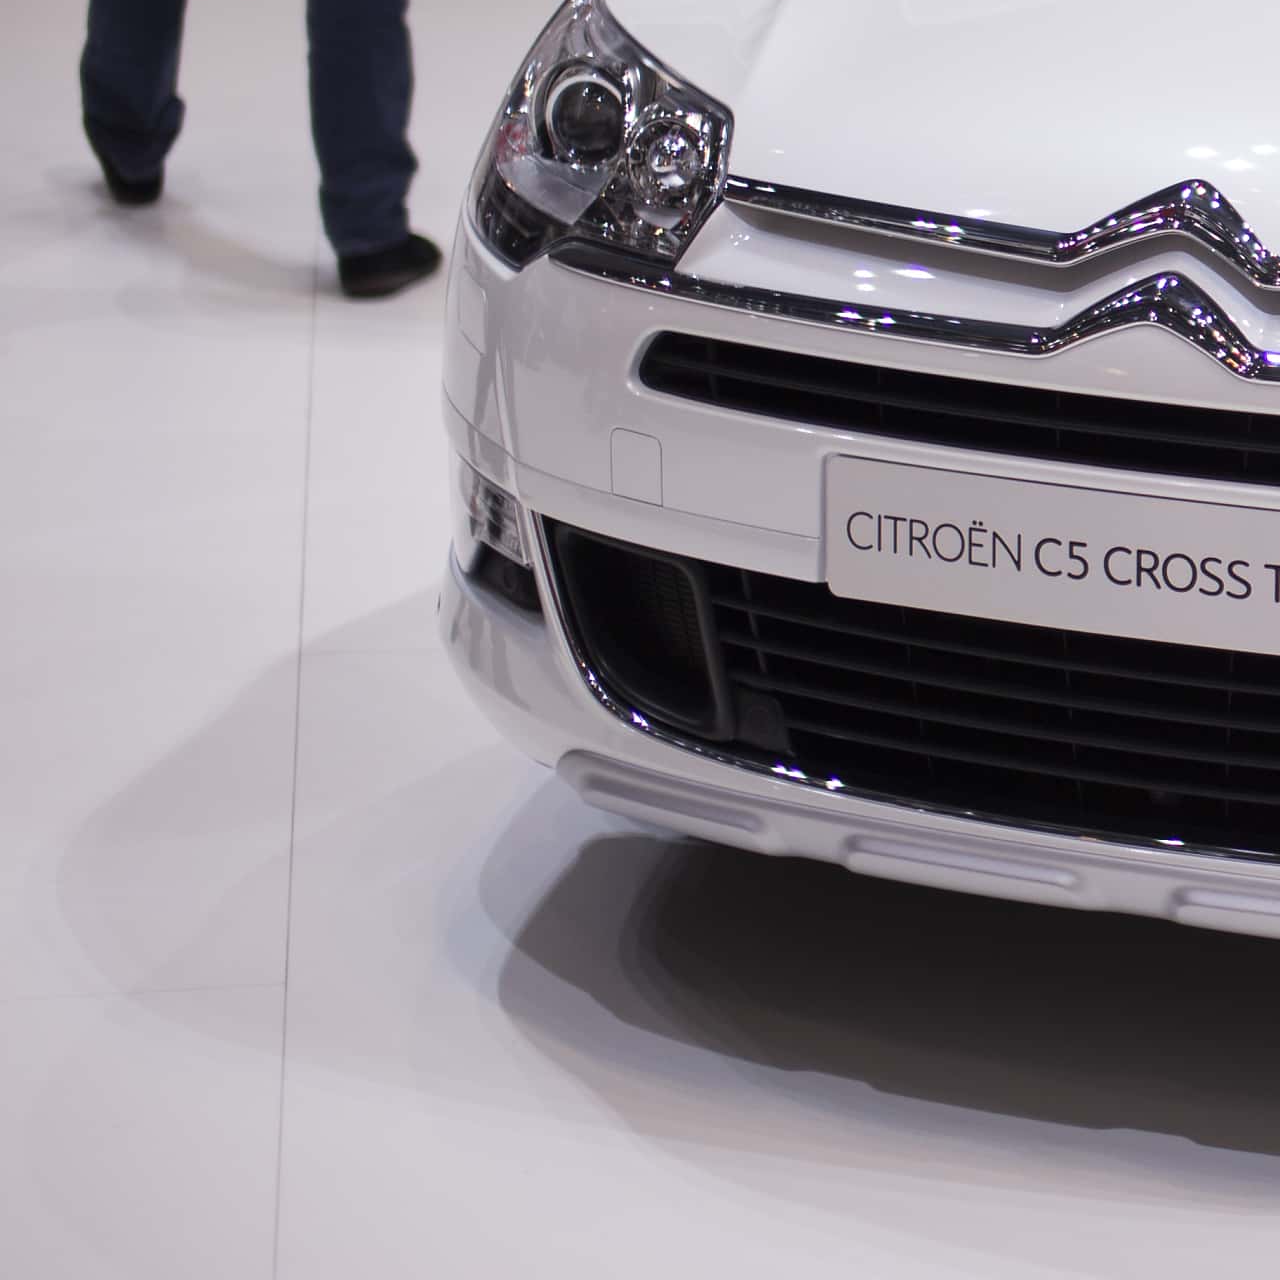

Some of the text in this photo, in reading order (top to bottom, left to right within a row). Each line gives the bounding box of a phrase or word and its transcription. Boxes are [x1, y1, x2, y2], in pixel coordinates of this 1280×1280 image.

[847, 512, 1021, 571] CITROËN
[1034, 538, 1089, 580] C5
[1104, 546, 1251, 599] CROSS
